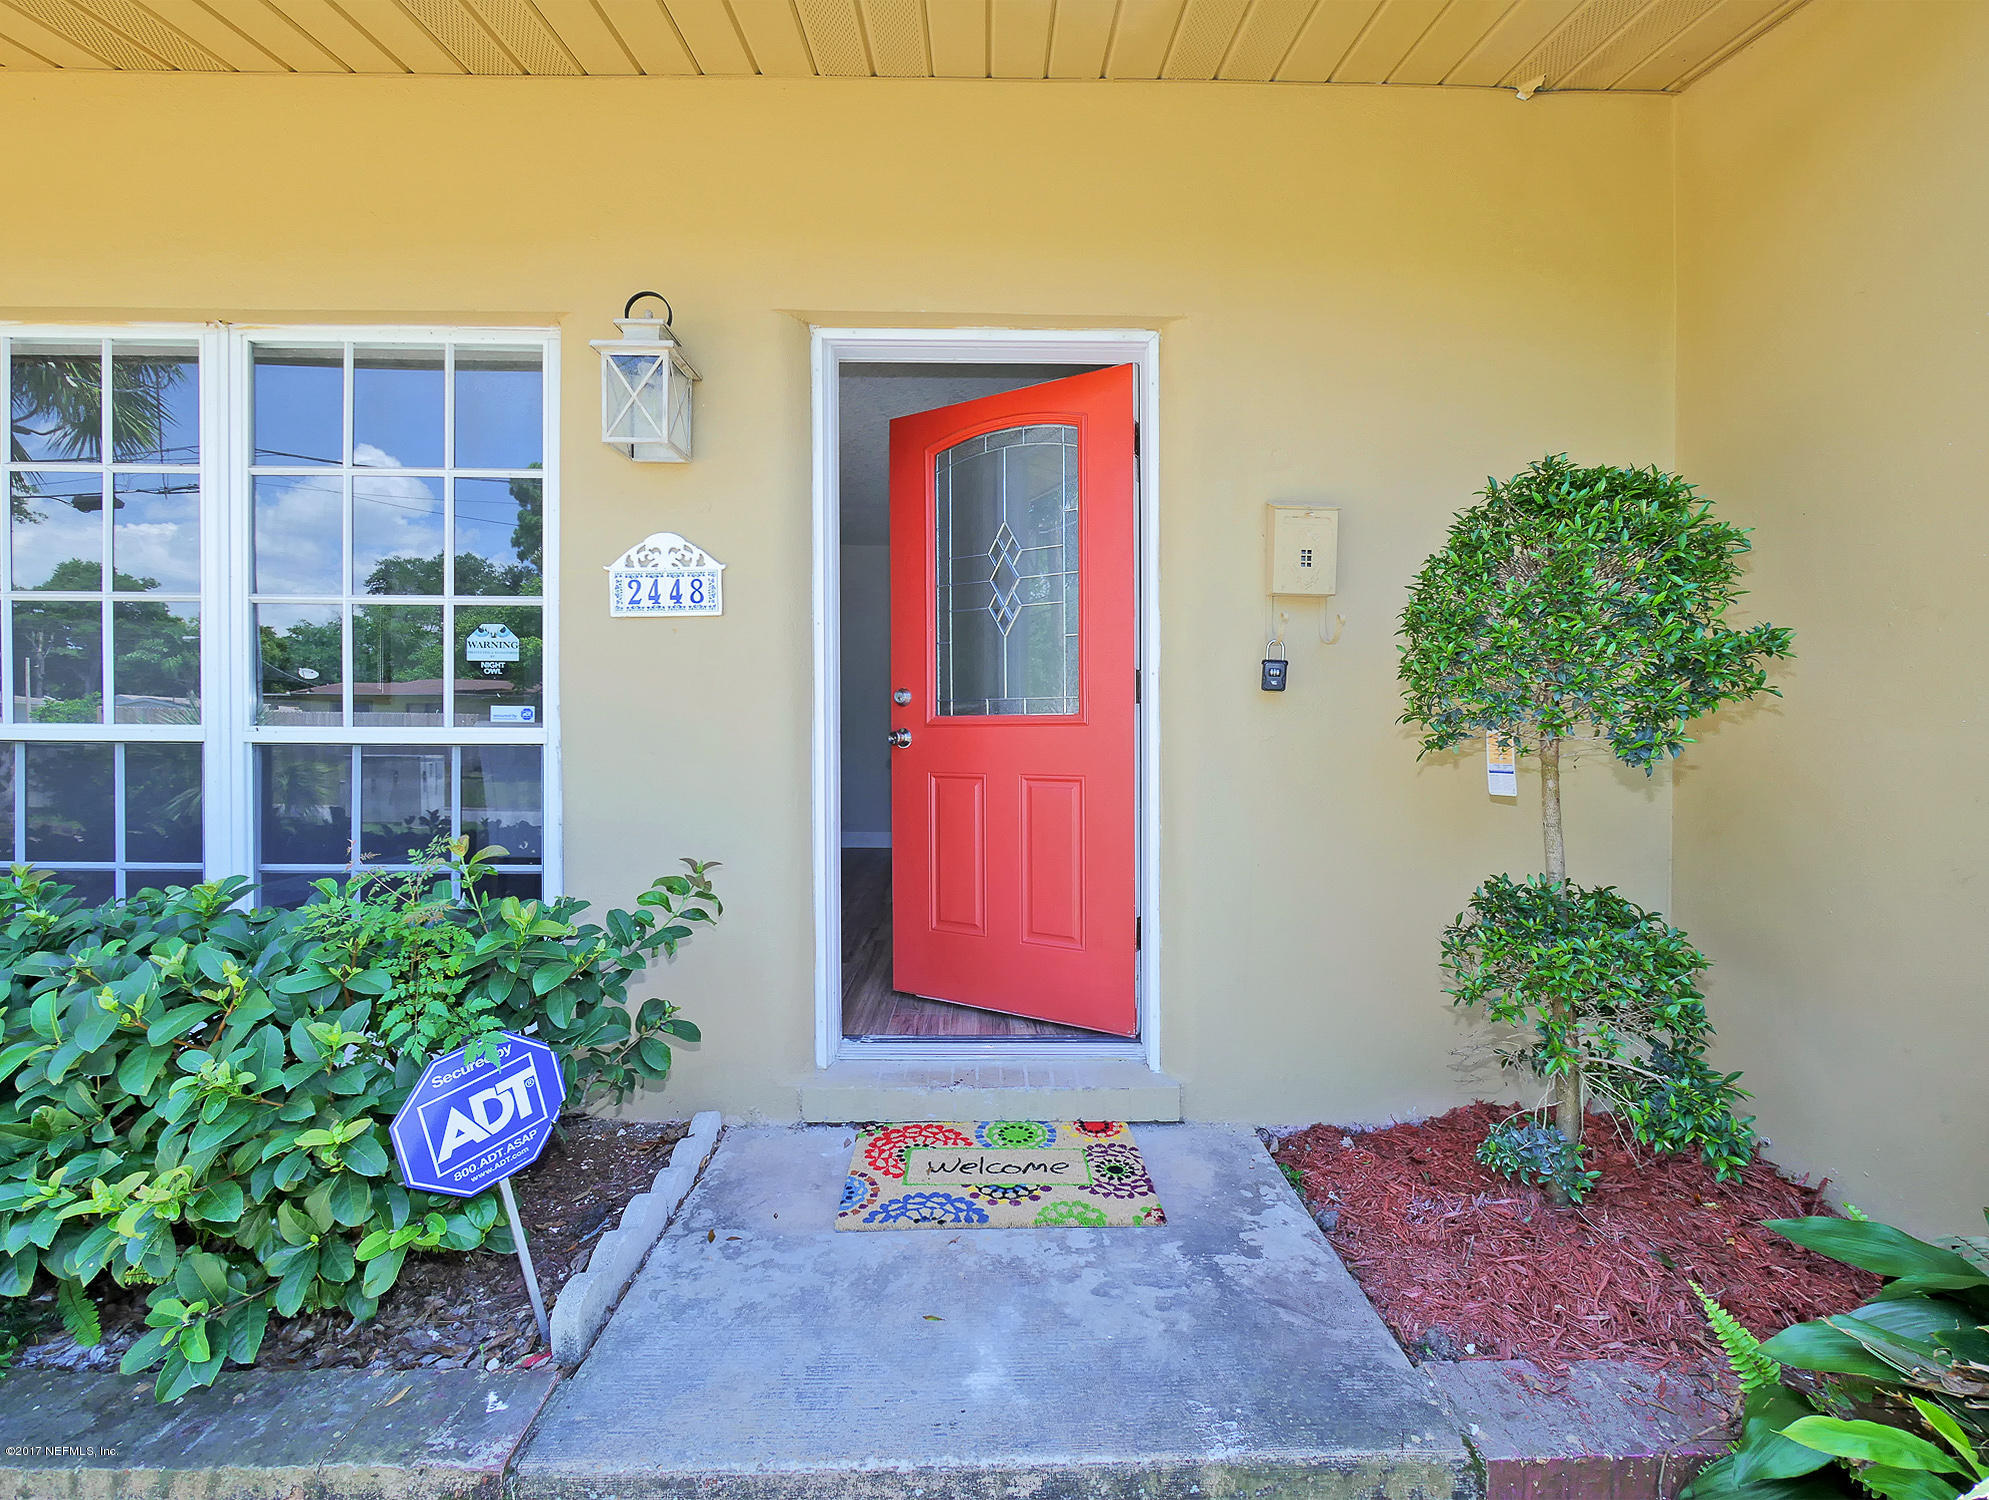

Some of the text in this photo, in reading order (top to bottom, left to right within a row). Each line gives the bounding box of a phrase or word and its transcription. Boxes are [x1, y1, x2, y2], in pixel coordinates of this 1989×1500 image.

[627, 578, 705, 605] 2448
[467, 640, 519, 650] WARNING
[480, 661, 506, 669] NIGHT
[453, 1129, 538, 1182] 800.ADT.ASAP
[470, 1146, 530, 1182] www.ADT.com
[927, 1155, 1070, 1175] Welcome
